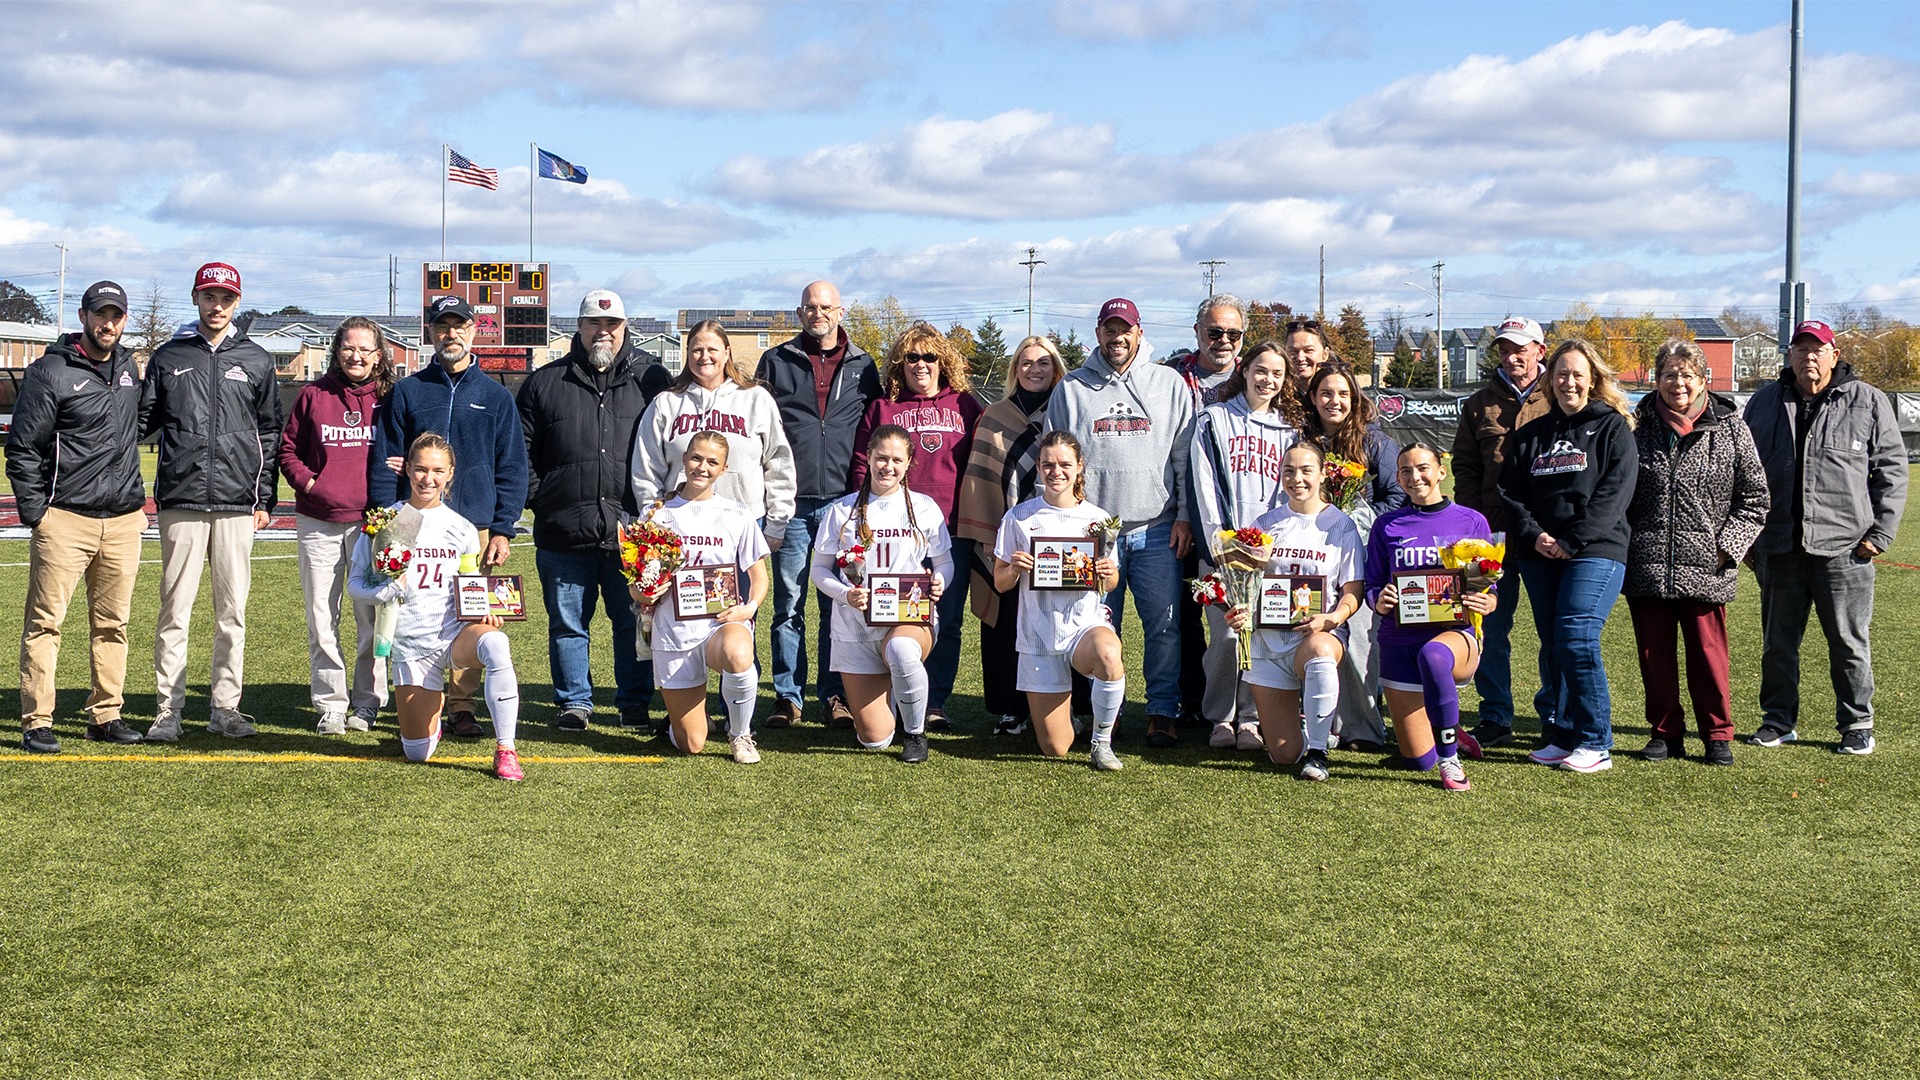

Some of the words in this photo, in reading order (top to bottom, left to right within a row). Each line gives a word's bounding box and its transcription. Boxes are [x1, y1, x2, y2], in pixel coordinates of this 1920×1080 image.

[202, 267, 238, 283] POTSDAM
[428, 263, 451, 271] GUESTS
[471, 263, 512, 281] 6:26
[522, 263, 540, 271] HOME
[440, 271, 451, 289] 0
[531, 272, 543, 290] 0
[512, 296, 540, 305] PENALTY
[474, 305, 497, 314] PERIOD
[1092, 418, 1151, 434] POTSDAM
[1555, 464, 1586, 472] SOCCER
[680, 535, 723, 547] TSDAM
[412, 547, 457, 560] TSDAM
[876, 542, 890, 568] 11
[1270, 547, 1327, 563] POTSDAM
[1395, 546, 1443, 568] POTS
[416, 563, 443, 589] 24
[1440, 728, 1456, 744] C
